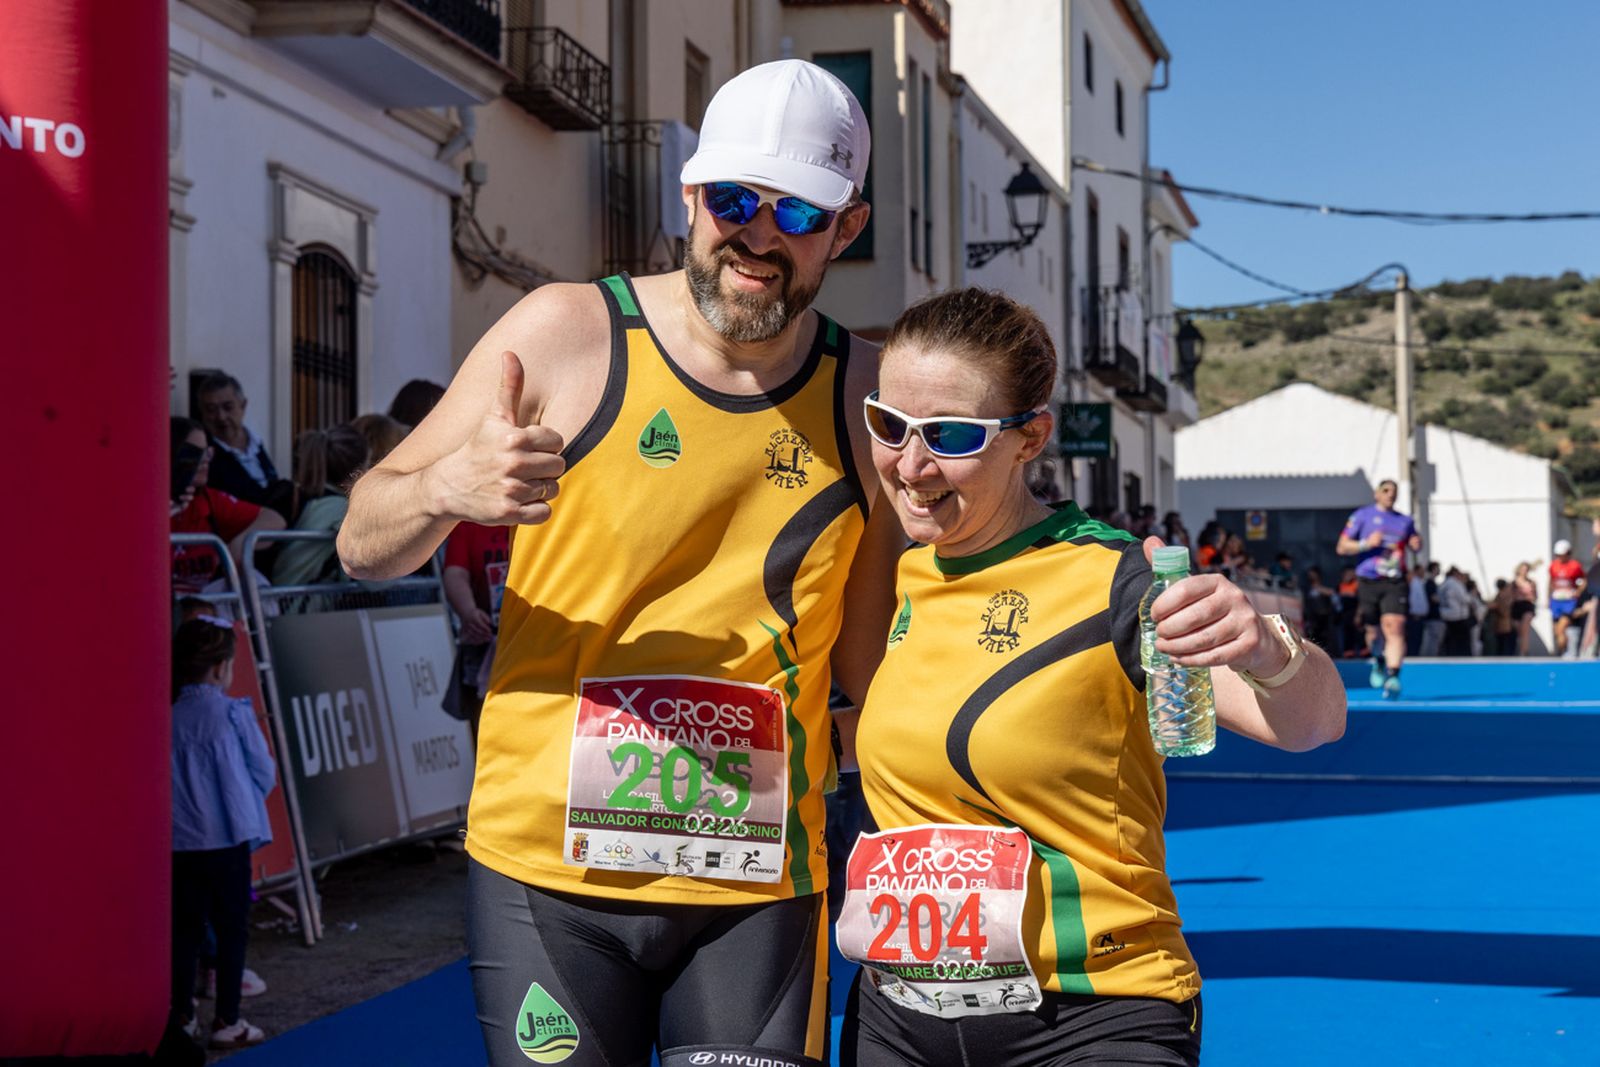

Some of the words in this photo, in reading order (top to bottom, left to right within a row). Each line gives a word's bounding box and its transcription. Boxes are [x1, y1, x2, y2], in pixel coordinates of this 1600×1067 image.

[641, 427, 678, 448] Jaén
[654, 440, 678, 449] clima
[608, 687, 645, 719] X
[649, 698, 754, 731] CROSS
[291, 688, 378, 777] UNED
[607, 722, 731, 751] PANTANO
[734, 738, 754, 749] DEL
[607, 742, 751, 817] 205
[571, 810, 647, 827] SALVADOR
[869, 840, 903, 873] X
[903, 846, 995, 873] CROSS
[866, 873, 966, 896] PANTANO
[970, 878, 987, 889] DEL
[867, 893, 987, 962] 204
[519, 1012, 569, 1041] Jaén
[536, 1027, 571, 1035] clima
